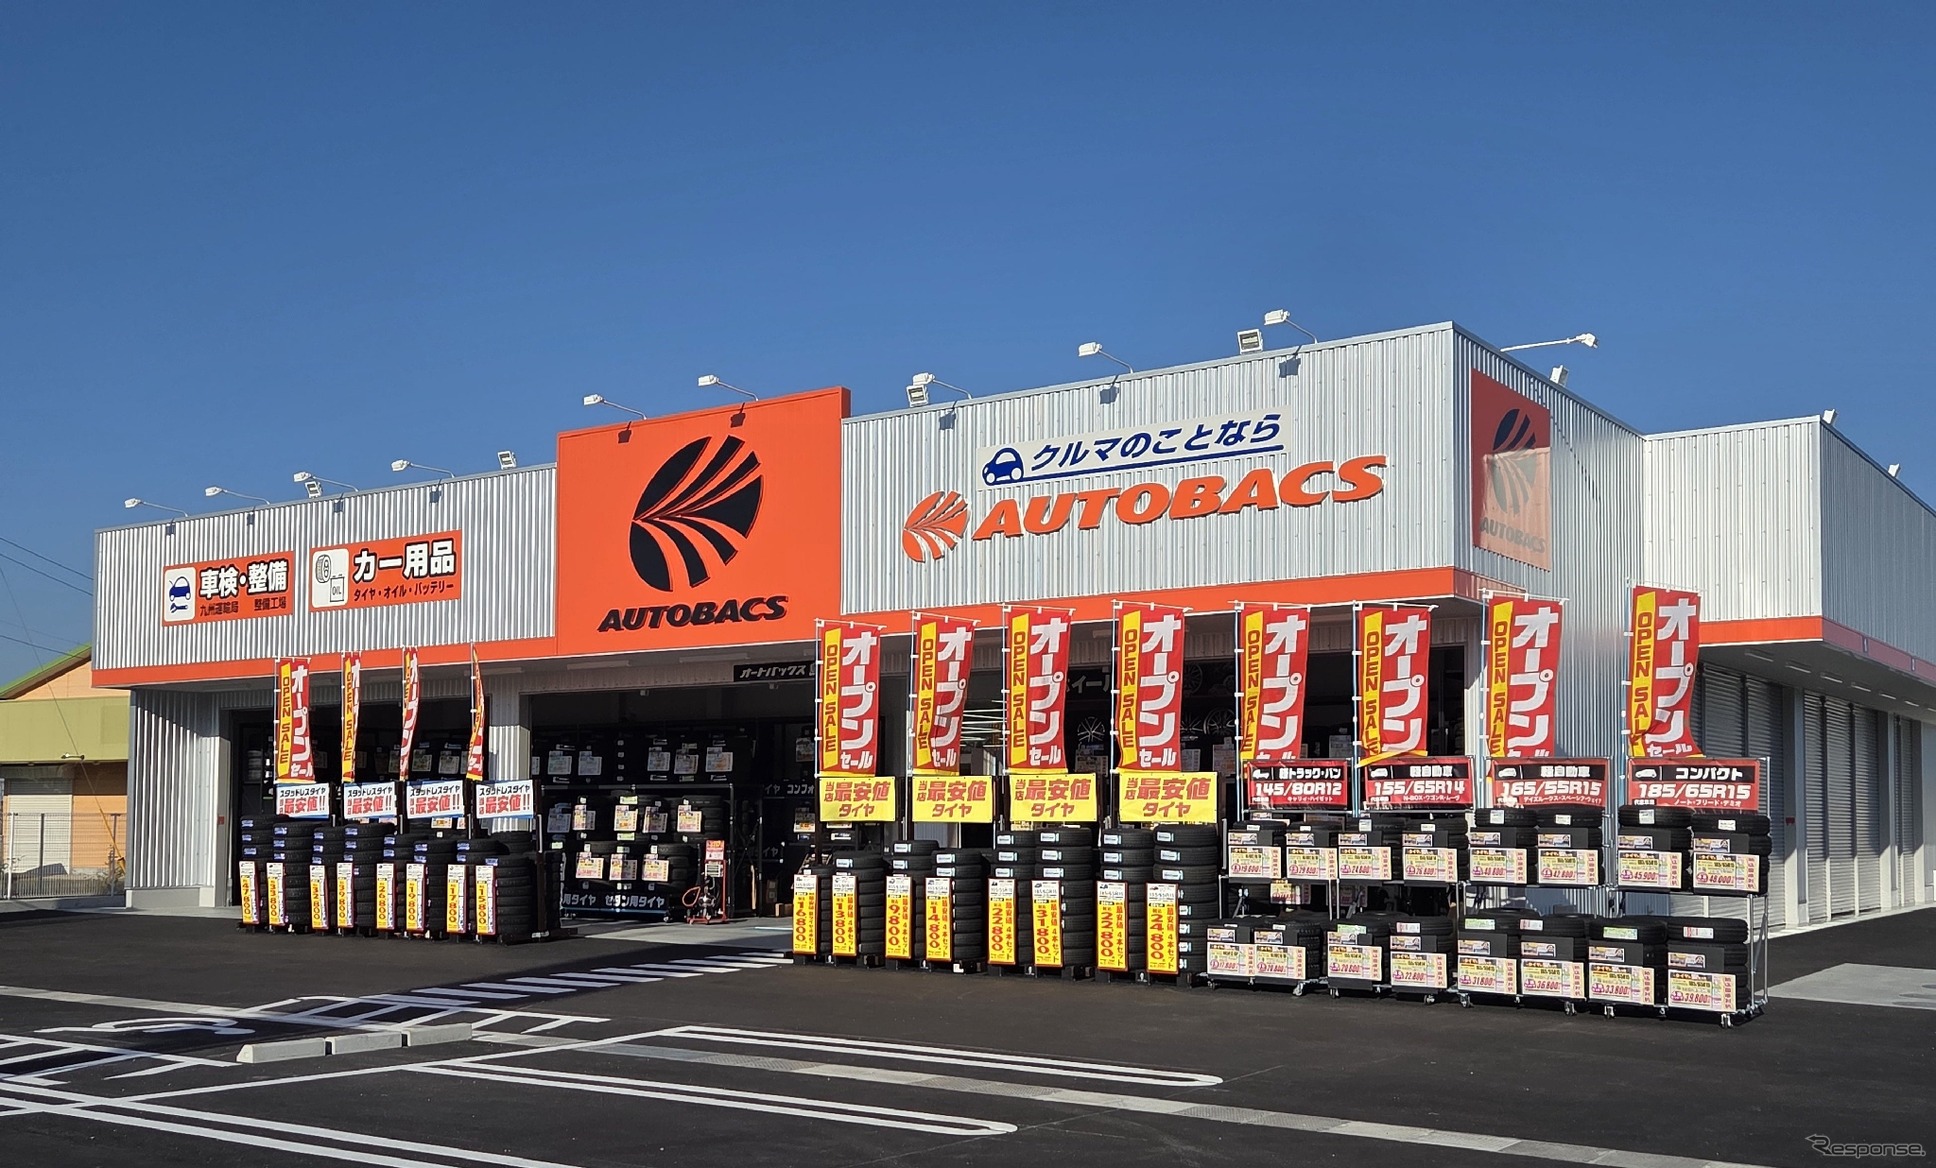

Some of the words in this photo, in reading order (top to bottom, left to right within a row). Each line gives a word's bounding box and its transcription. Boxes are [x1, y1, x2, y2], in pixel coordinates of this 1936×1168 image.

[1031, 413, 1284, 472] クルマのことなら
[972, 455, 1389, 542] AUTOBACS
[1480, 516, 1546, 553] AUTOBACS
[199, 558, 288, 599] 車検・整備
[352, 538, 456, 583] カー用品
[354, 581, 454, 601] タイヤ・オイル・バッテリー
[597, 596, 789, 632] AUTOBACS
[921, 638, 934, 691] OPEN
[1013, 631, 1026, 686] OPEN
[1123, 628, 1138, 686] OPEN
[1247, 630, 1260, 689] OPEN
[1366, 631, 1380, 692] OPEN
[1494, 621, 1507, 683] OPEN
[1635, 612, 1651, 677] OPEN
[825, 645, 838, 696] OPEN
[841, 631, 877, 750] オープン
[931, 627, 972, 748] オープン
[1029, 617, 1068, 746] オープン
[1139, 614, 1182, 747] オープン
[1258, 615, 1307, 750] オープン
[1382, 615, 1427, 752] オープン
[1507, 607, 1559, 748] オープン
[1645, 598, 1697, 745] オープン
[292, 665, 312, 762] オープン
[825, 703, 837, 752] SALE
[918, 698, 931, 750] SALE
[1012, 693, 1025, 748] SALE
[1121, 693, 1135, 749] SALE
[1241, 696, 1258, 752] SALE
[1361, 699, 1380, 755] SALE
[1489, 692, 1506, 756] SALE
[1630, 687, 1649, 738] SAL
[280, 724, 291, 764] SALE
[344, 720, 352, 761] SALE
[841, 752, 873, 769] セール
[932, 749, 957, 767] セール
[1029, 745, 1061, 766] セール
[1139, 748, 1177, 768] セール
[280, 787, 325, 798] スタッドレスタイヤ
[348, 786, 392, 798] スタッドレスタイヤ
[410, 785, 460, 796] スタッドレスタイヤ
[480, 784, 530, 796] スタッドレスタイヤ
[834, 781, 890, 802] 最安値
[927, 780, 987, 802] 最安値
[1025, 778, 1091, 801] 最安値
[1137, 777, 1211, 800] 最安値
[1255, 782, 1342, 797] 145/80R12
[1375, 781, 1465, 795] 155/65R14
[1503, 781, 1601, 796] 165/55R15
[1639, 783, 1751, 799] 185/65R15
[1675, 767, 1743, 781] コンパクト
[839, 804, 875, 817] タイヤ
[932, 803, 972, 817] タイヤ
[1031, 803, 1075, 817] タイヤ
[1143, 802, 1191, 817] タイヤ
[563, 893, 596, 906] 用タイヤ
